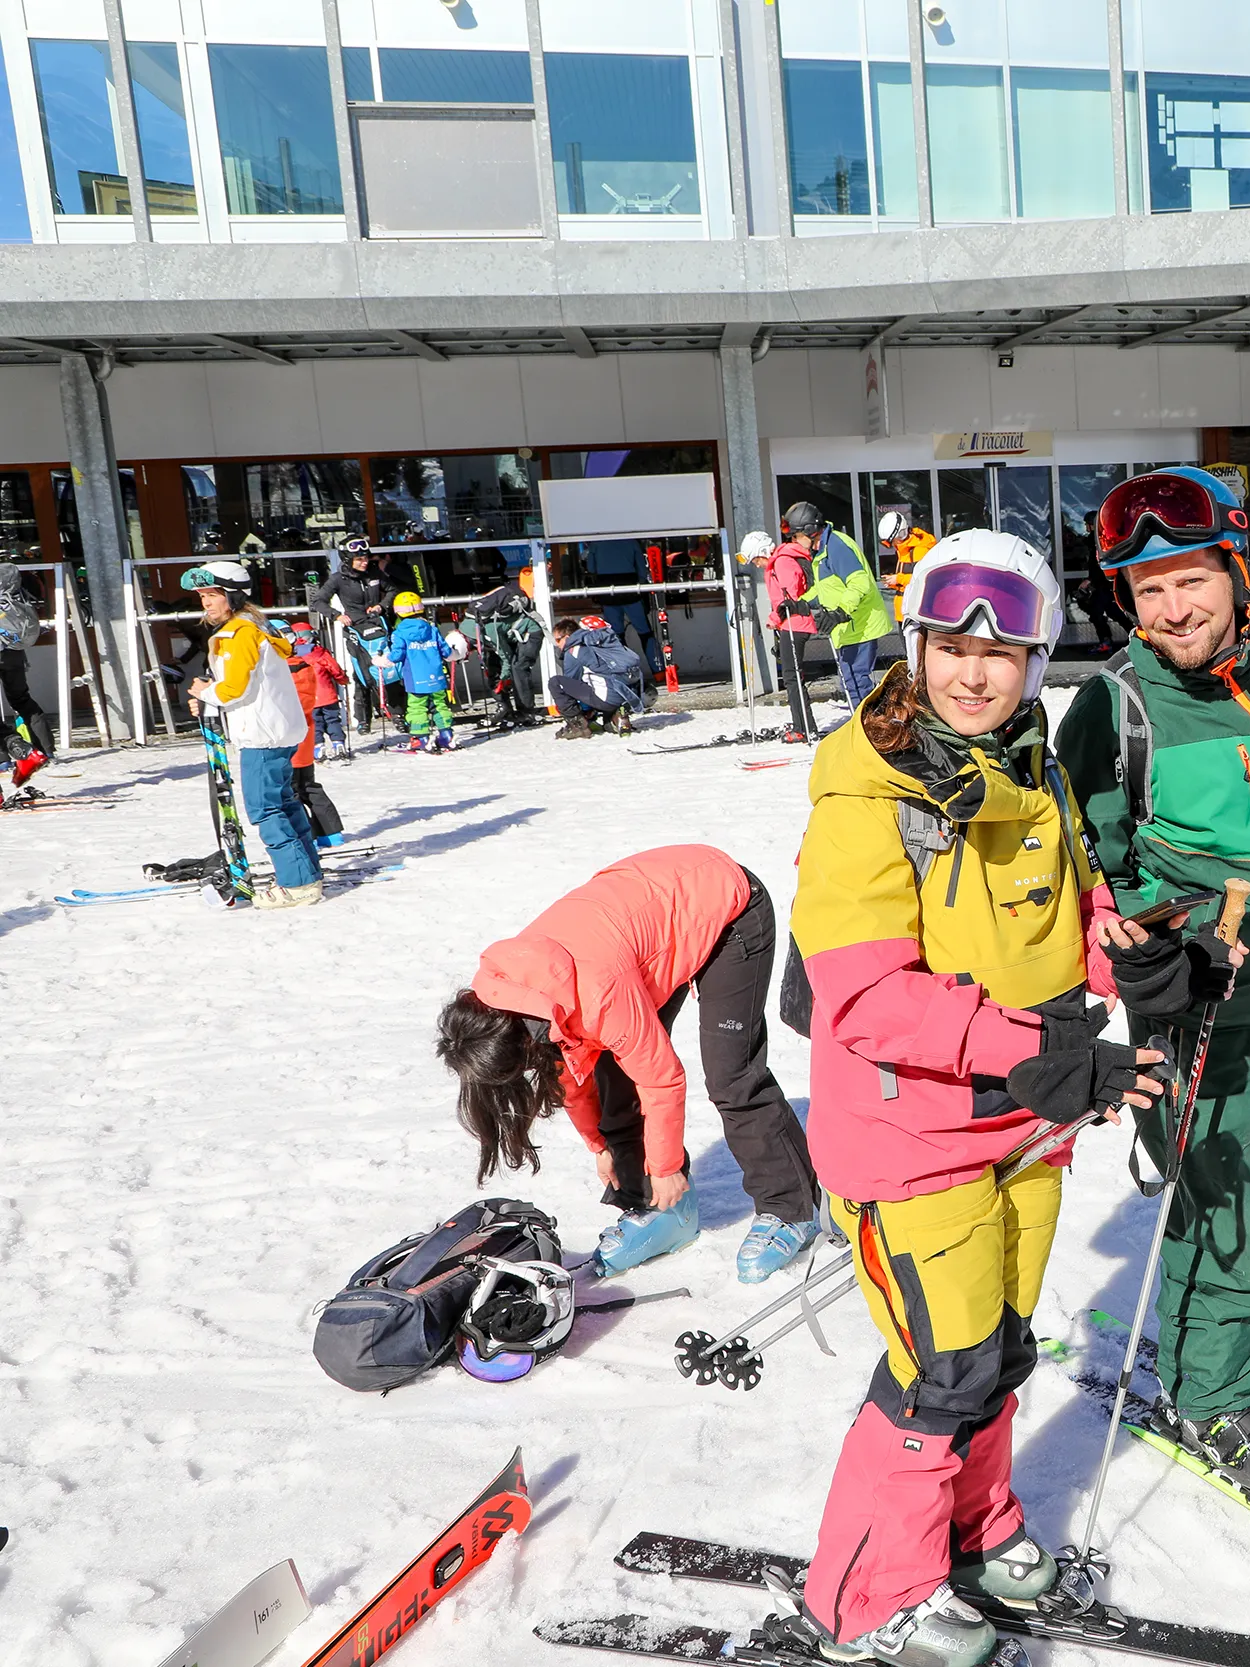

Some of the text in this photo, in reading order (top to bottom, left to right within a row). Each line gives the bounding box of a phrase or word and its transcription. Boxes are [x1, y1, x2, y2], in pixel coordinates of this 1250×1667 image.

[413, 565, 425, 592] HEAD
[1191, 1032, 1207, 1078] LEKI
[258, 1607, 270, 1624] 161
[357, 1622, 369, 1655] GS
